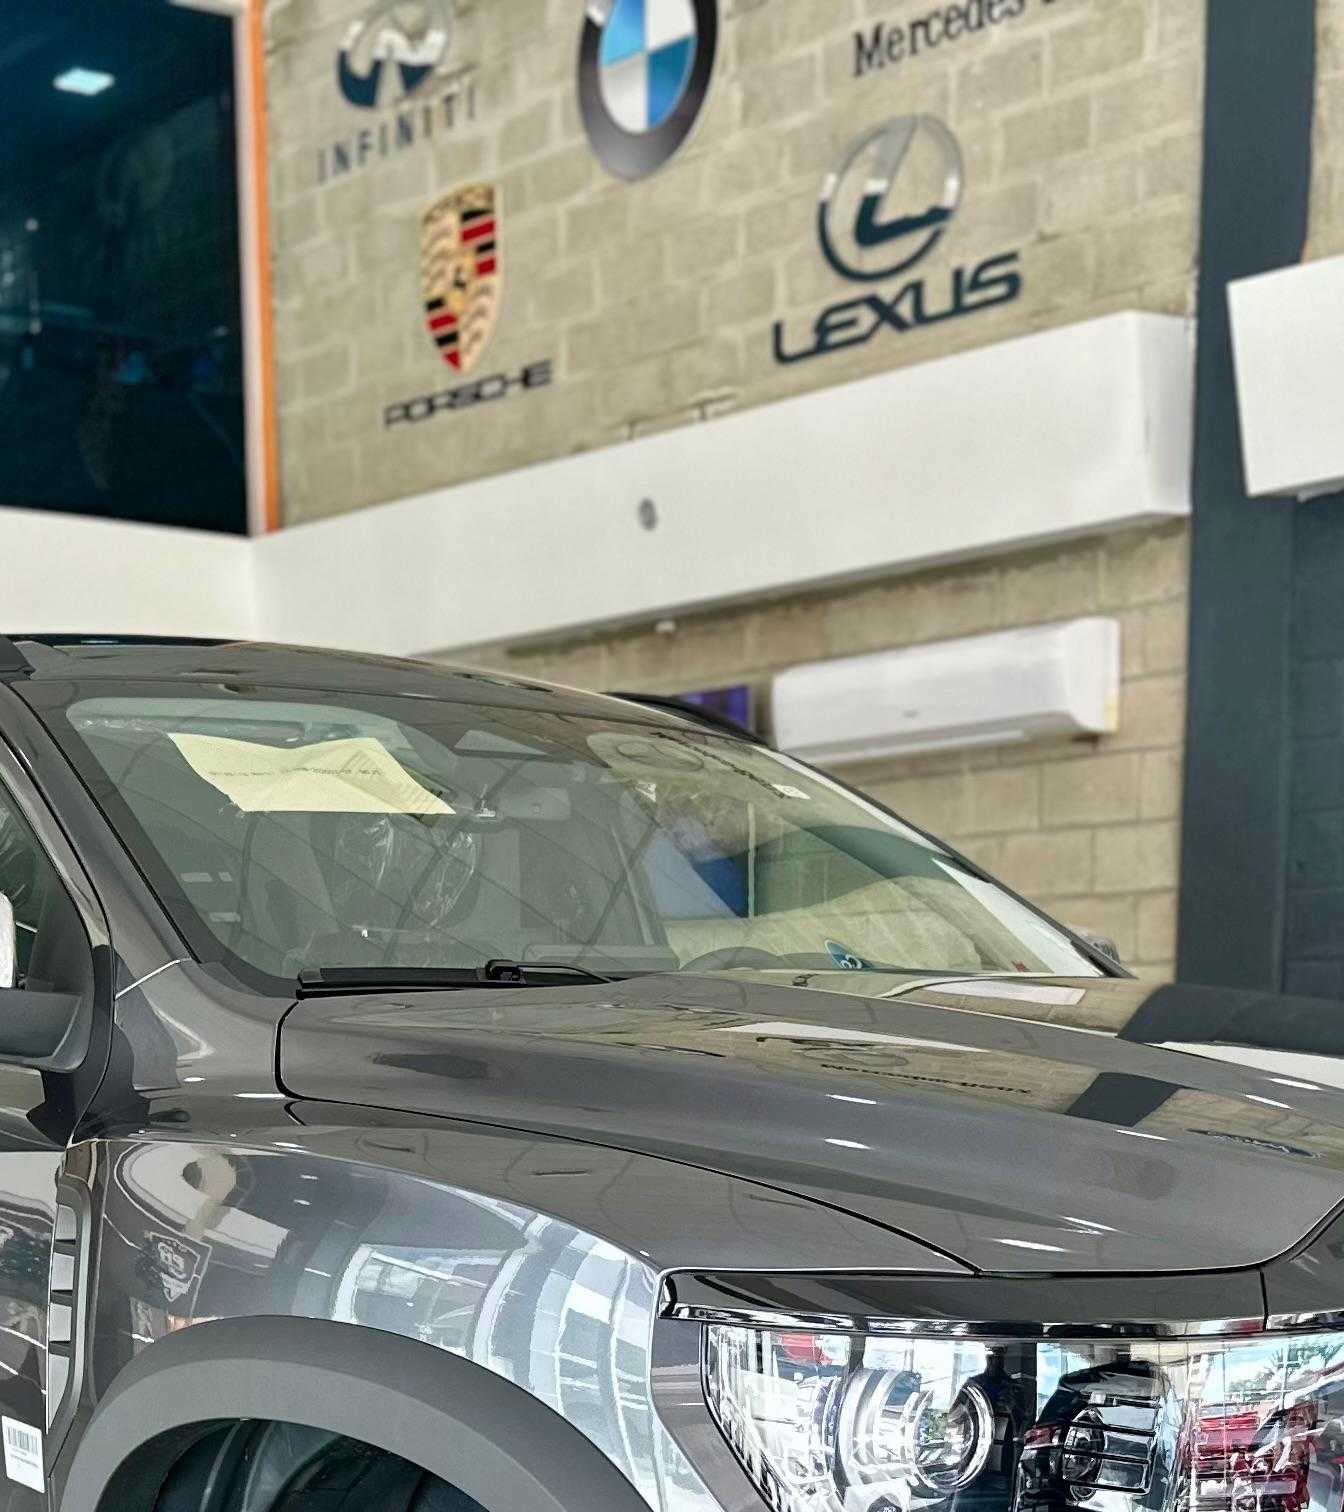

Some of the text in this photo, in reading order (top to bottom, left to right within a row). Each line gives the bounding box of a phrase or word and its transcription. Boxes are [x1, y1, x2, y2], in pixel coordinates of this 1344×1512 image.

[317, 87, 478, 183] INFINITI
[774, 251, 1023, 366] LEXUS
[383, 358, 555, 431] PORSCHE
